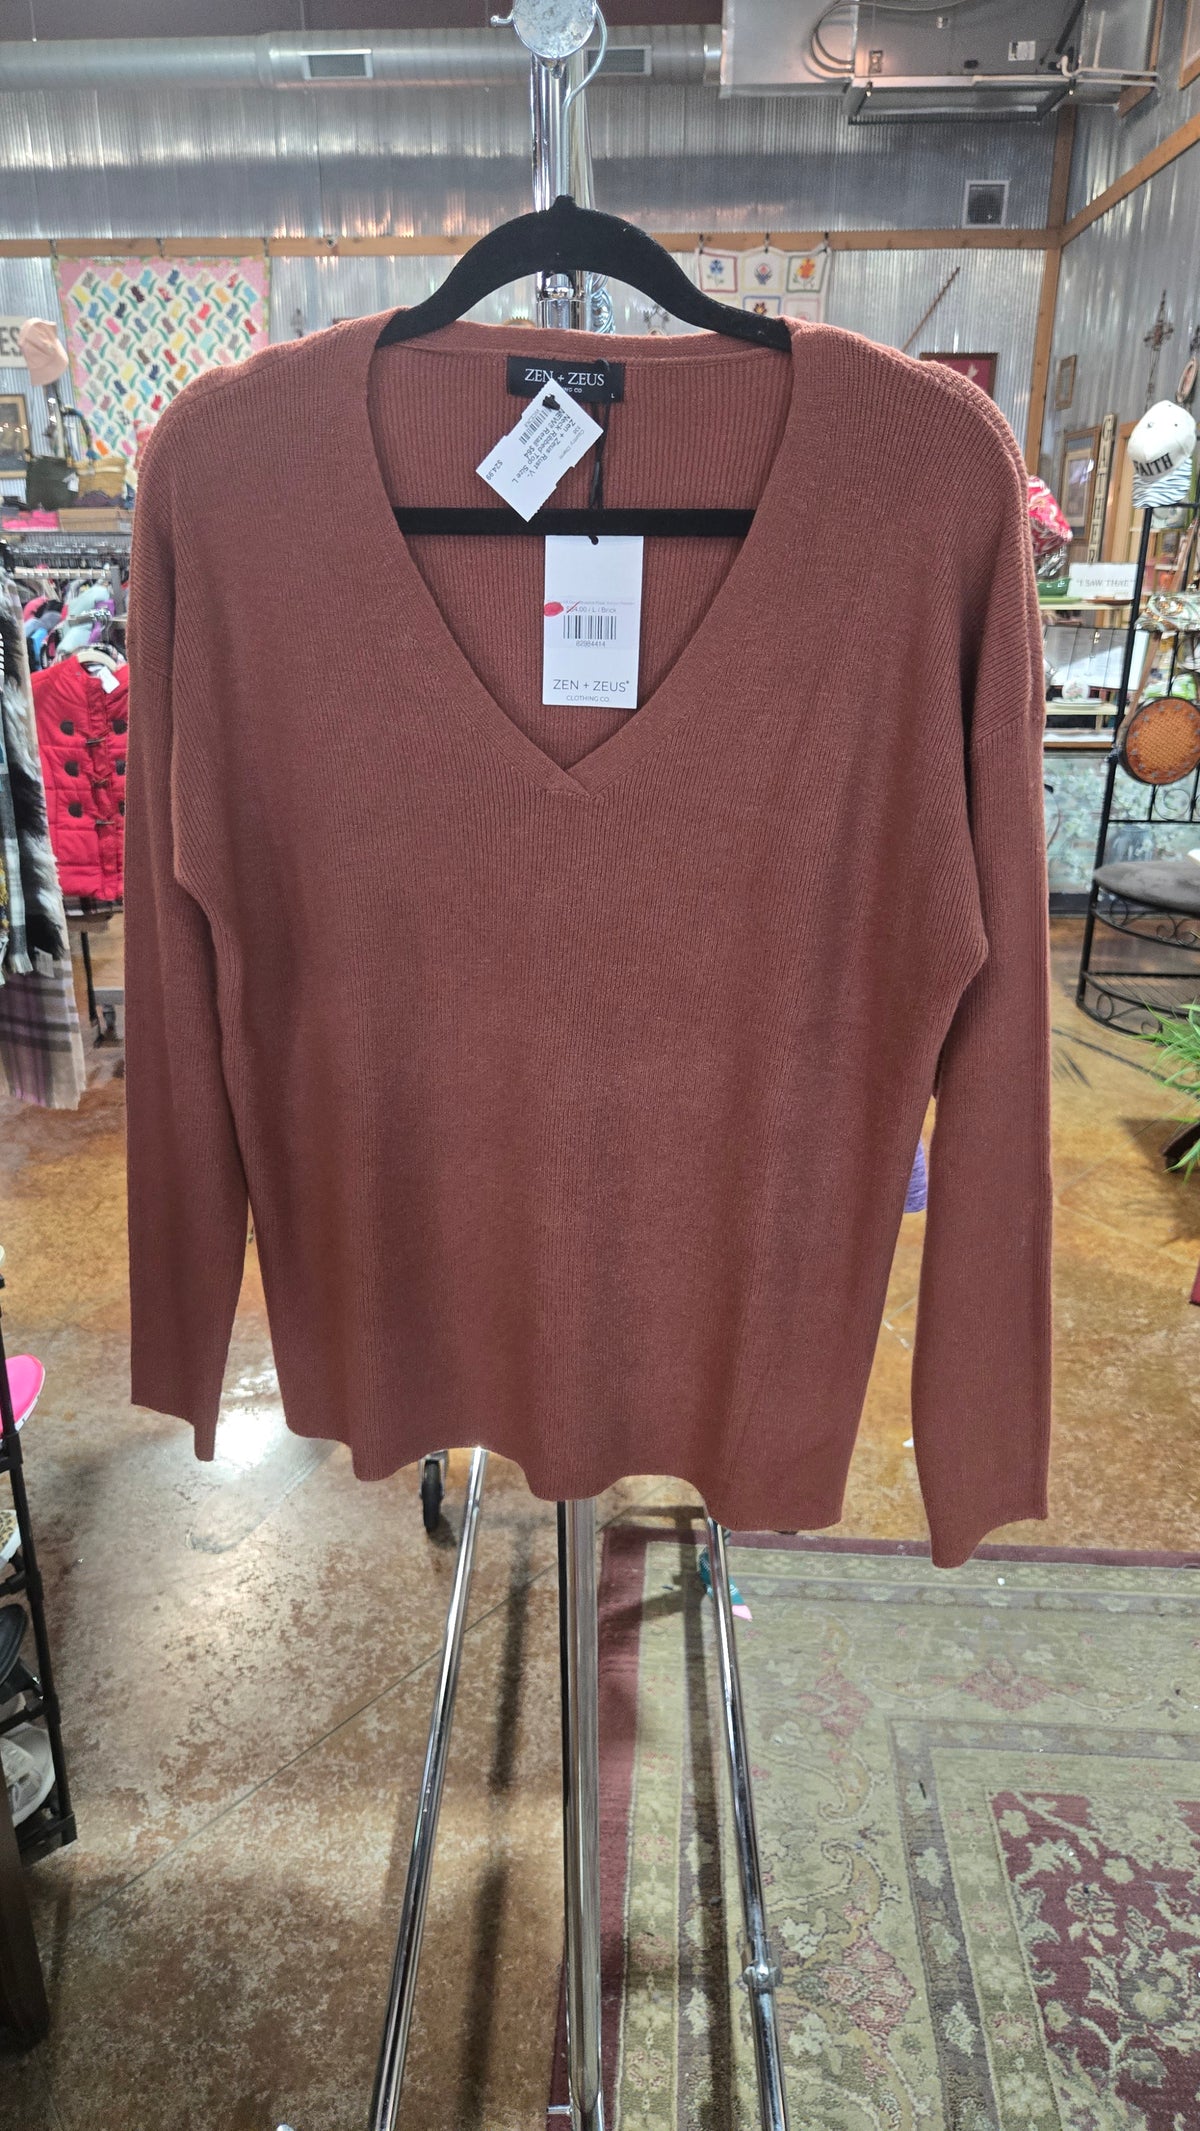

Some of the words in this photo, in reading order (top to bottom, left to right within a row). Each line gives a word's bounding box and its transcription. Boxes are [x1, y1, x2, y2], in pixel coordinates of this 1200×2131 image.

[524, 368, 554, 382] ZEN
[568, 372, 605, 386] ZEUS
[555, 414, 570, 430] Neck
[563, 419, 575, 432] Zen
[532, 427, 549, 446] Retail
[537, 430, 556, 452] Ribbed
[524, 446, 534, 458] $64
[546, 438, 560, 454] Zeus
[526, 452, 538, 465] Top
[534, 454, 546, 468] Rust
[1132, 453, 1172, 476] FAITH
[485, 459, 502, 479] $24.99
[516, 464, 528, 479] Size
[553, 679, 579, 690] ZEN
